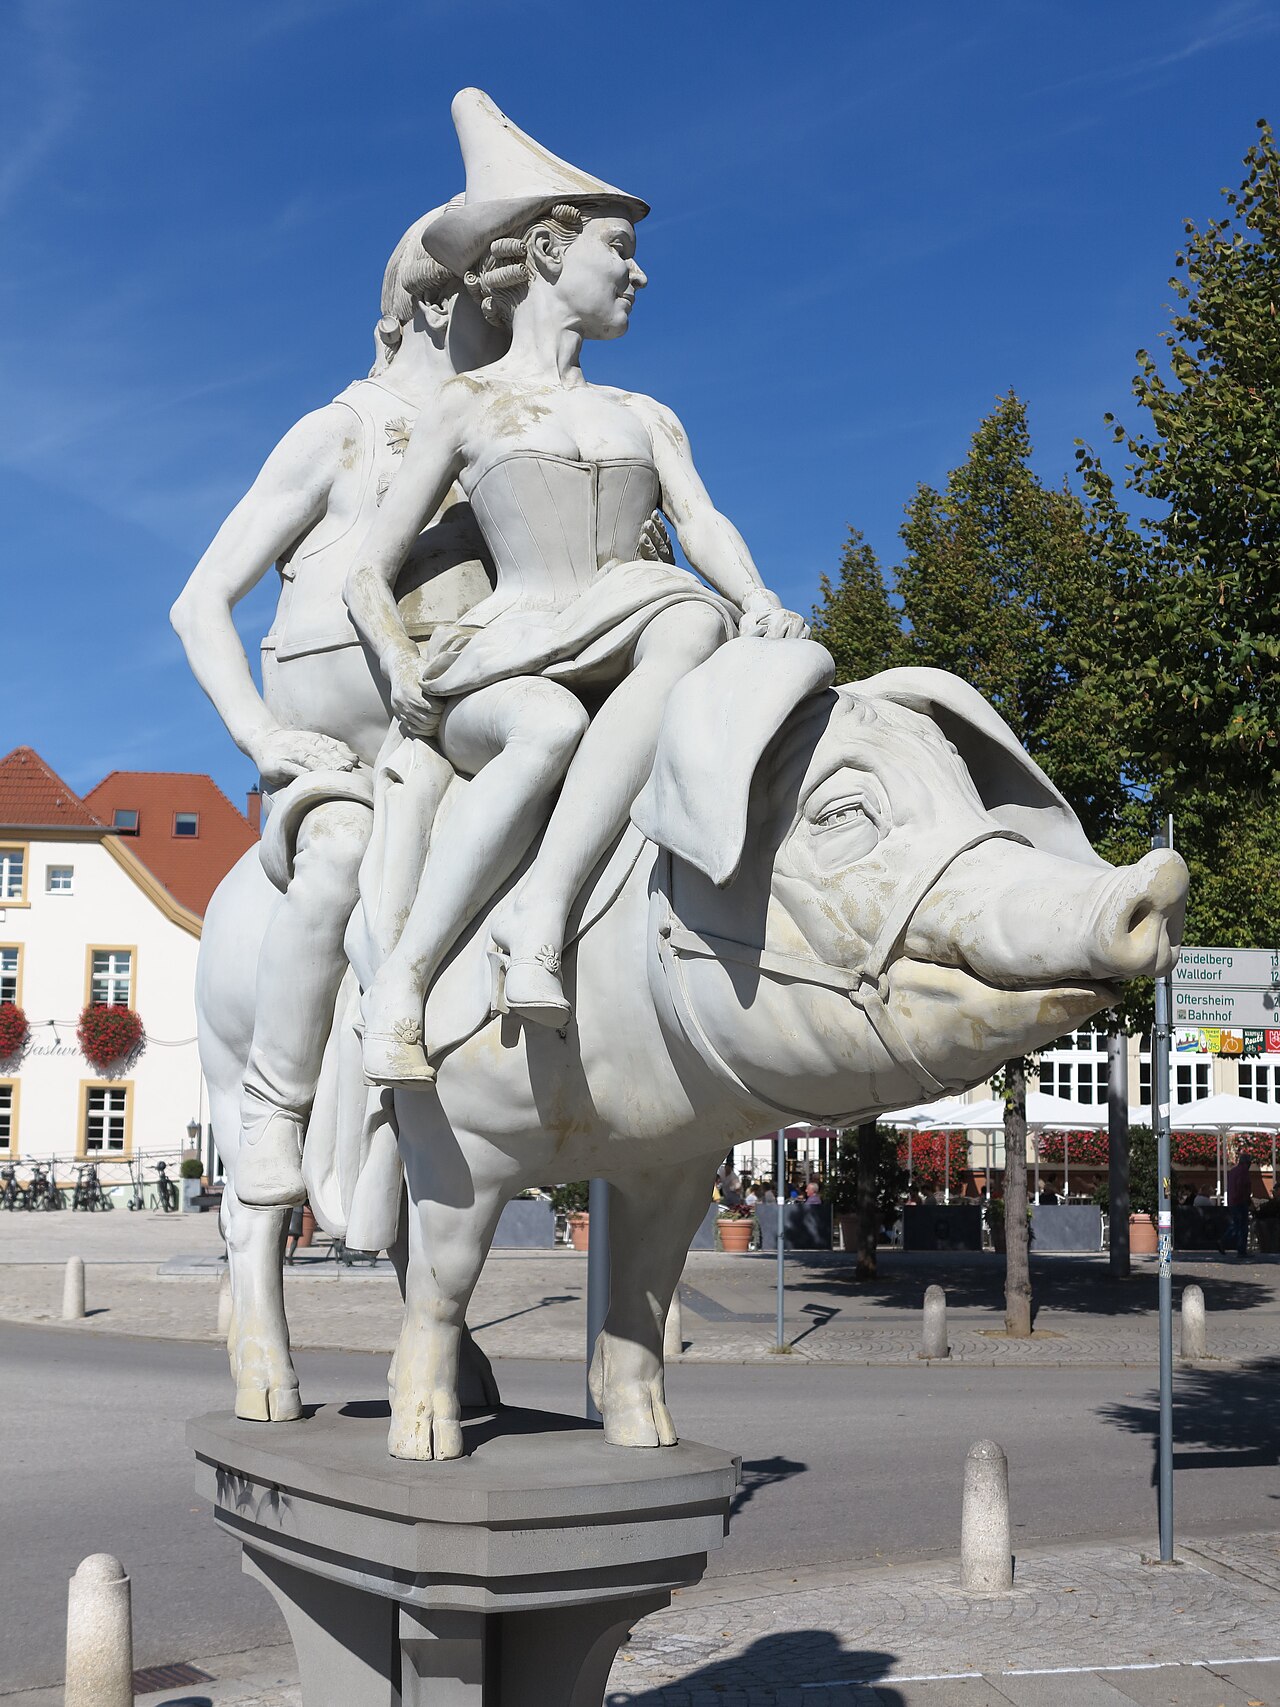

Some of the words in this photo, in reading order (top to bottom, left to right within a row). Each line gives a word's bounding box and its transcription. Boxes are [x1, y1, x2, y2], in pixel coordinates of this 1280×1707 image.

[1178, 953, 1233, 968] Heidelberg
[1176, 968, 1223, 981] Walldorf
[1176, 993, 1235, 1006] Oftersheim
[1188, 1009, 1232, 1021] Bahnhof
